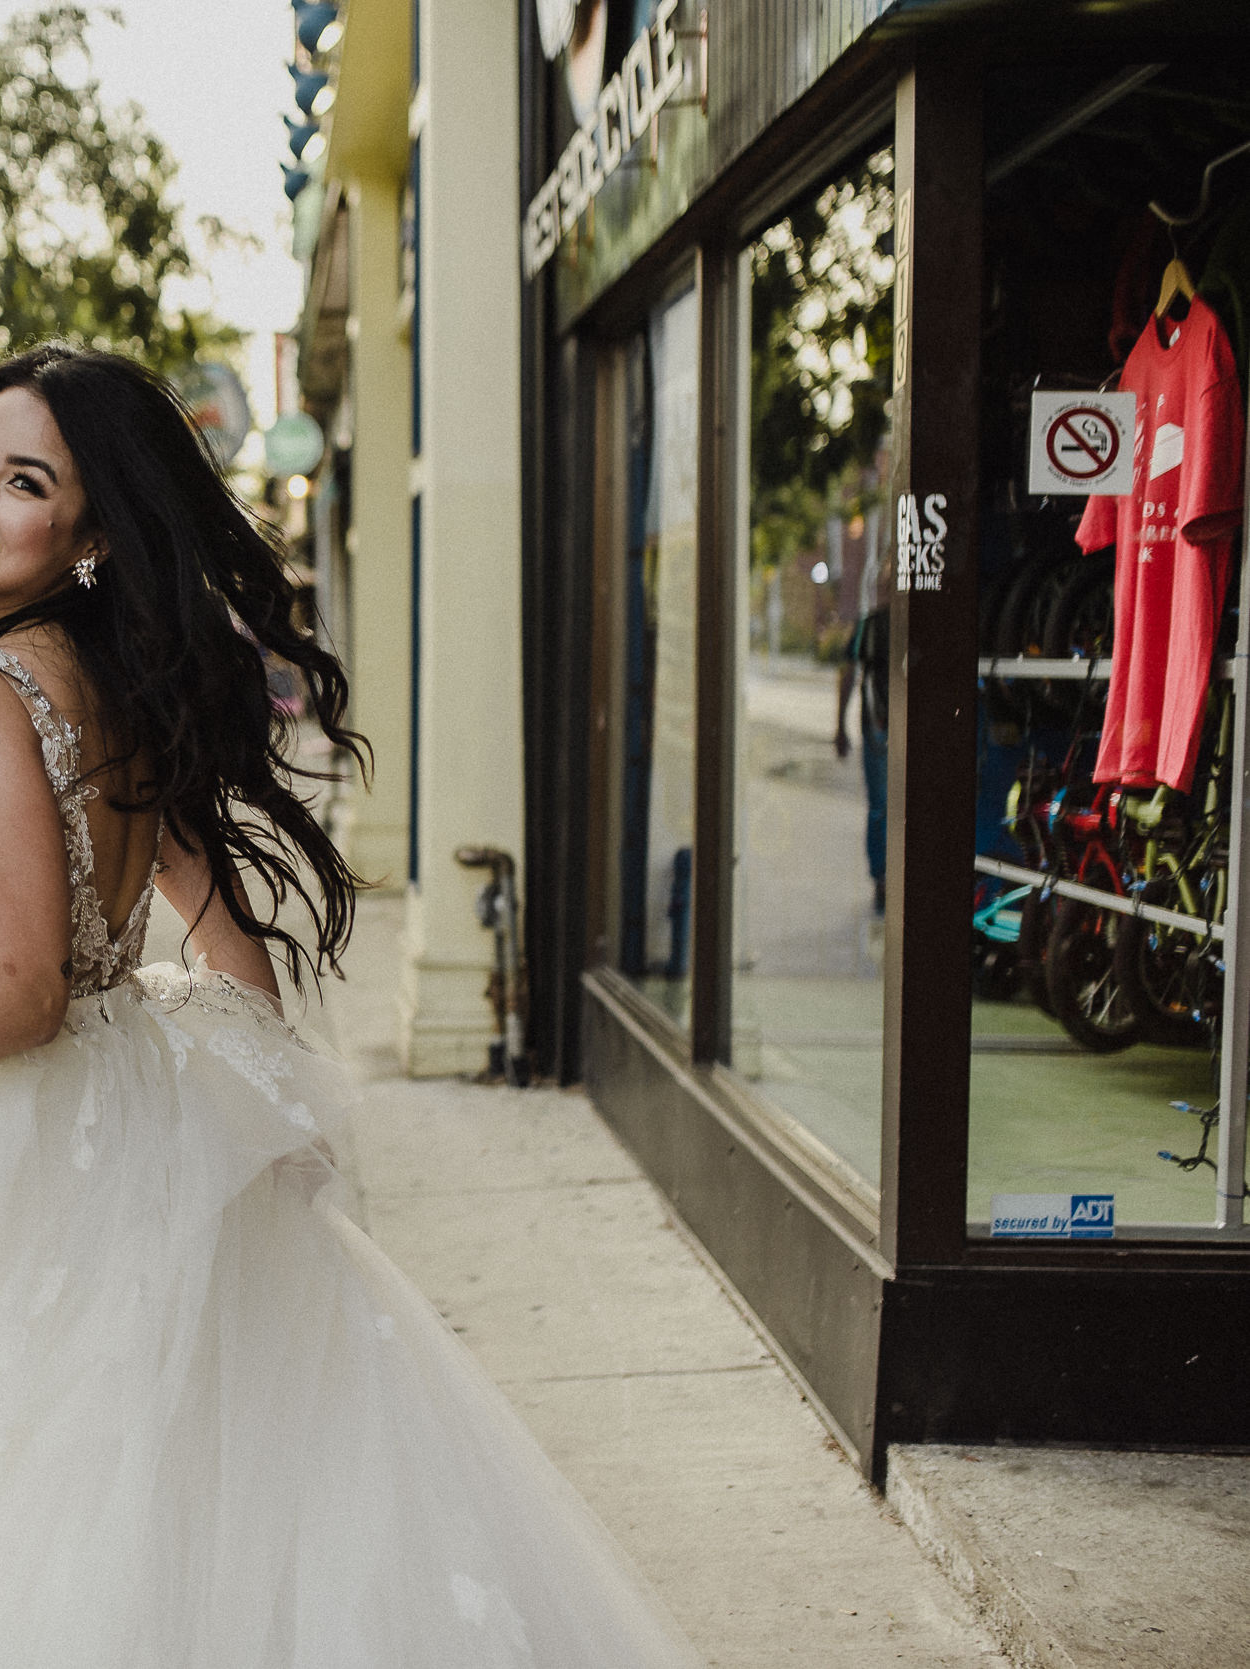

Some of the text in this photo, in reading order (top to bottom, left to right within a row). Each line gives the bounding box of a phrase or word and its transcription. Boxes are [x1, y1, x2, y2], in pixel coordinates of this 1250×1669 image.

[523, 168, 561, 280] EST
[599, 0, 684, 178] CYCLE
[897, 493, 948, 543] GAS
[994, 1199, 1115, 1232] secured by ADT
